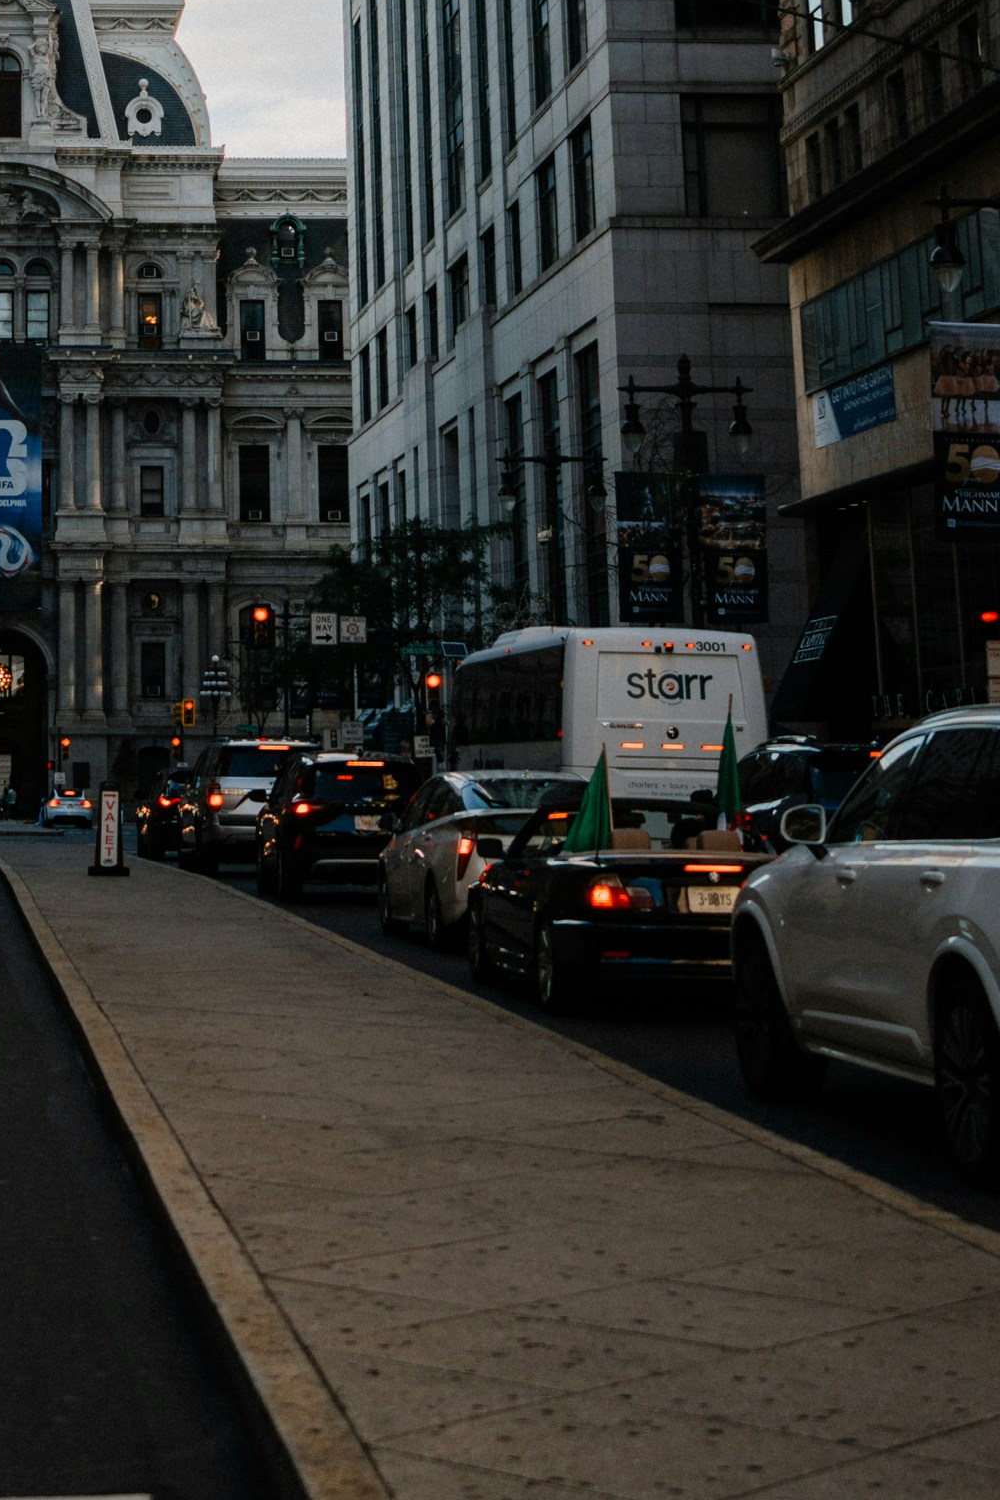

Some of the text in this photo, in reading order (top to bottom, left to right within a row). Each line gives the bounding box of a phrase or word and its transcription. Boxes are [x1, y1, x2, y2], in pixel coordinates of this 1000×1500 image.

[944, 443, 1000, 485] 50
[942, 495, 999, 513] MANN
[631, 554, 671, 582] 50
[716, 556, 756, 585] 50
[629, 590, 669, 603] MANN
[714, 592, 755, 605] MANN
[315, 615, 333, 623] ONE
[315, 624, 333, 632] WAY
[401, 647, 435, 655] CHESTNUT
[695, 641, 727, 652] 3001
[626, 668, 713, 700] starr
[871, 692, 904, 717] THE
[627, 781, 659, 789] charters
[104, 800, 116, 858] VALET
